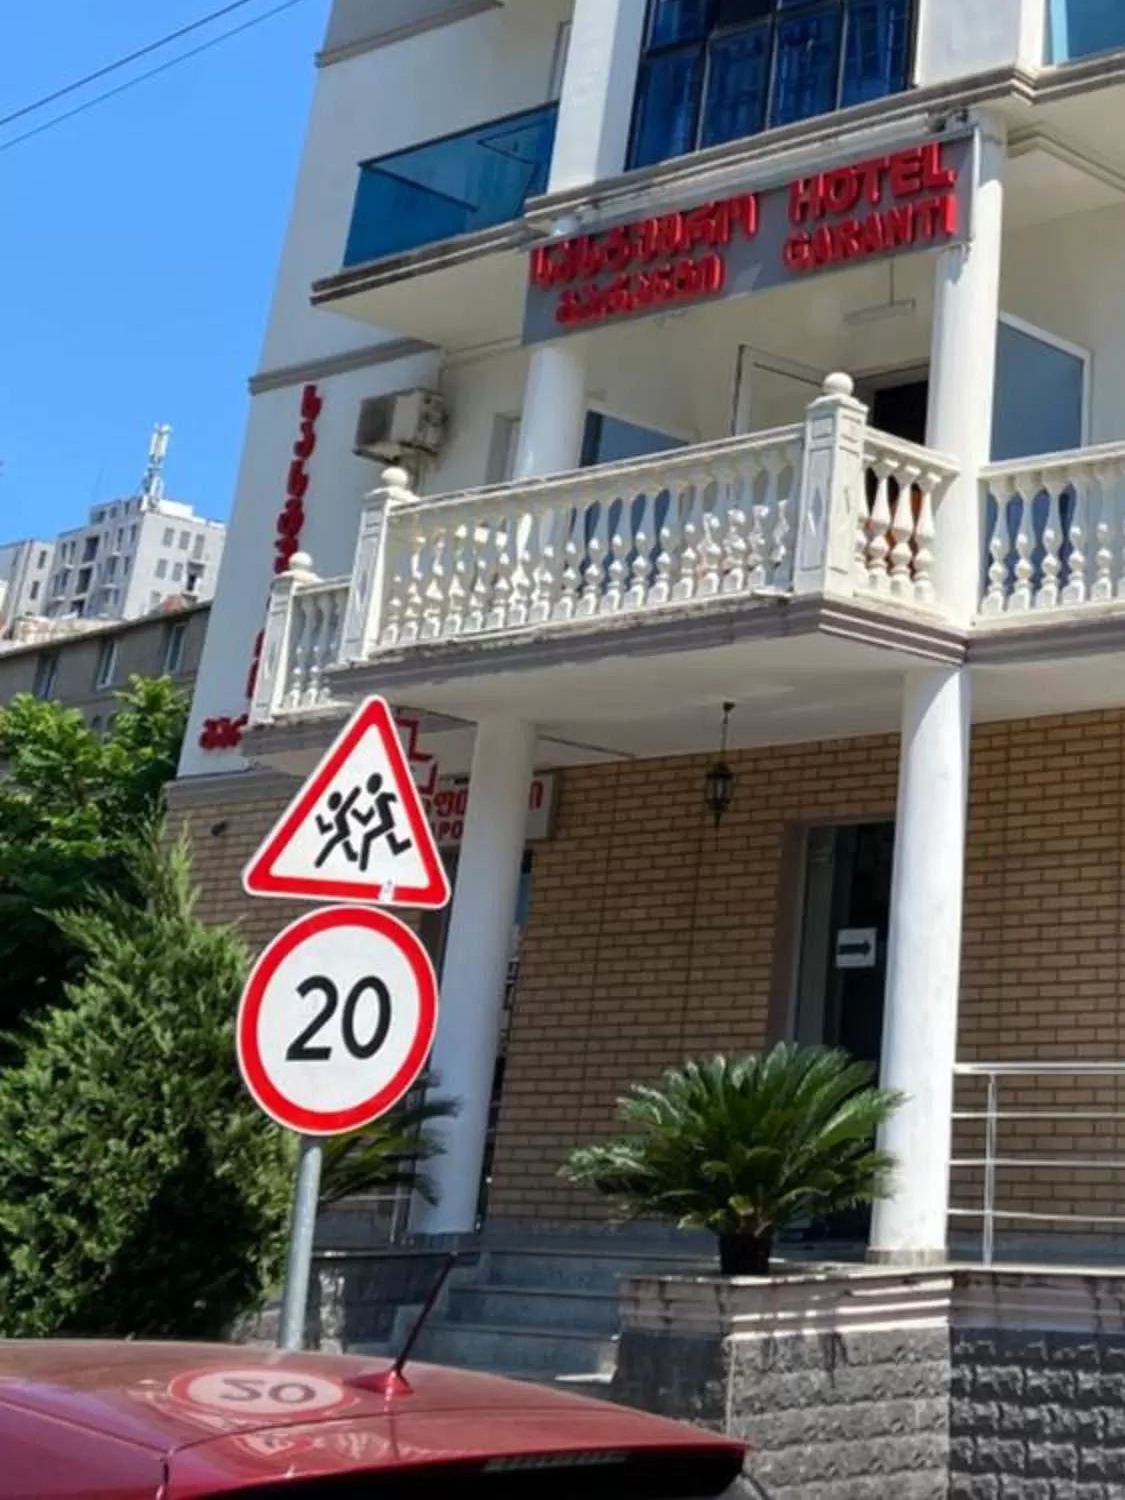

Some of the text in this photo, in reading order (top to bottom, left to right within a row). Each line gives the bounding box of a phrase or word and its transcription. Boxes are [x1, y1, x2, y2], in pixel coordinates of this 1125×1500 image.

[787, 140, 957, 225] HOTEL
[530, 193, 758, 291] სასტუმრო
[782, 195, 959, 272] GARANTI
[285, 975, 393, 1061] 20
